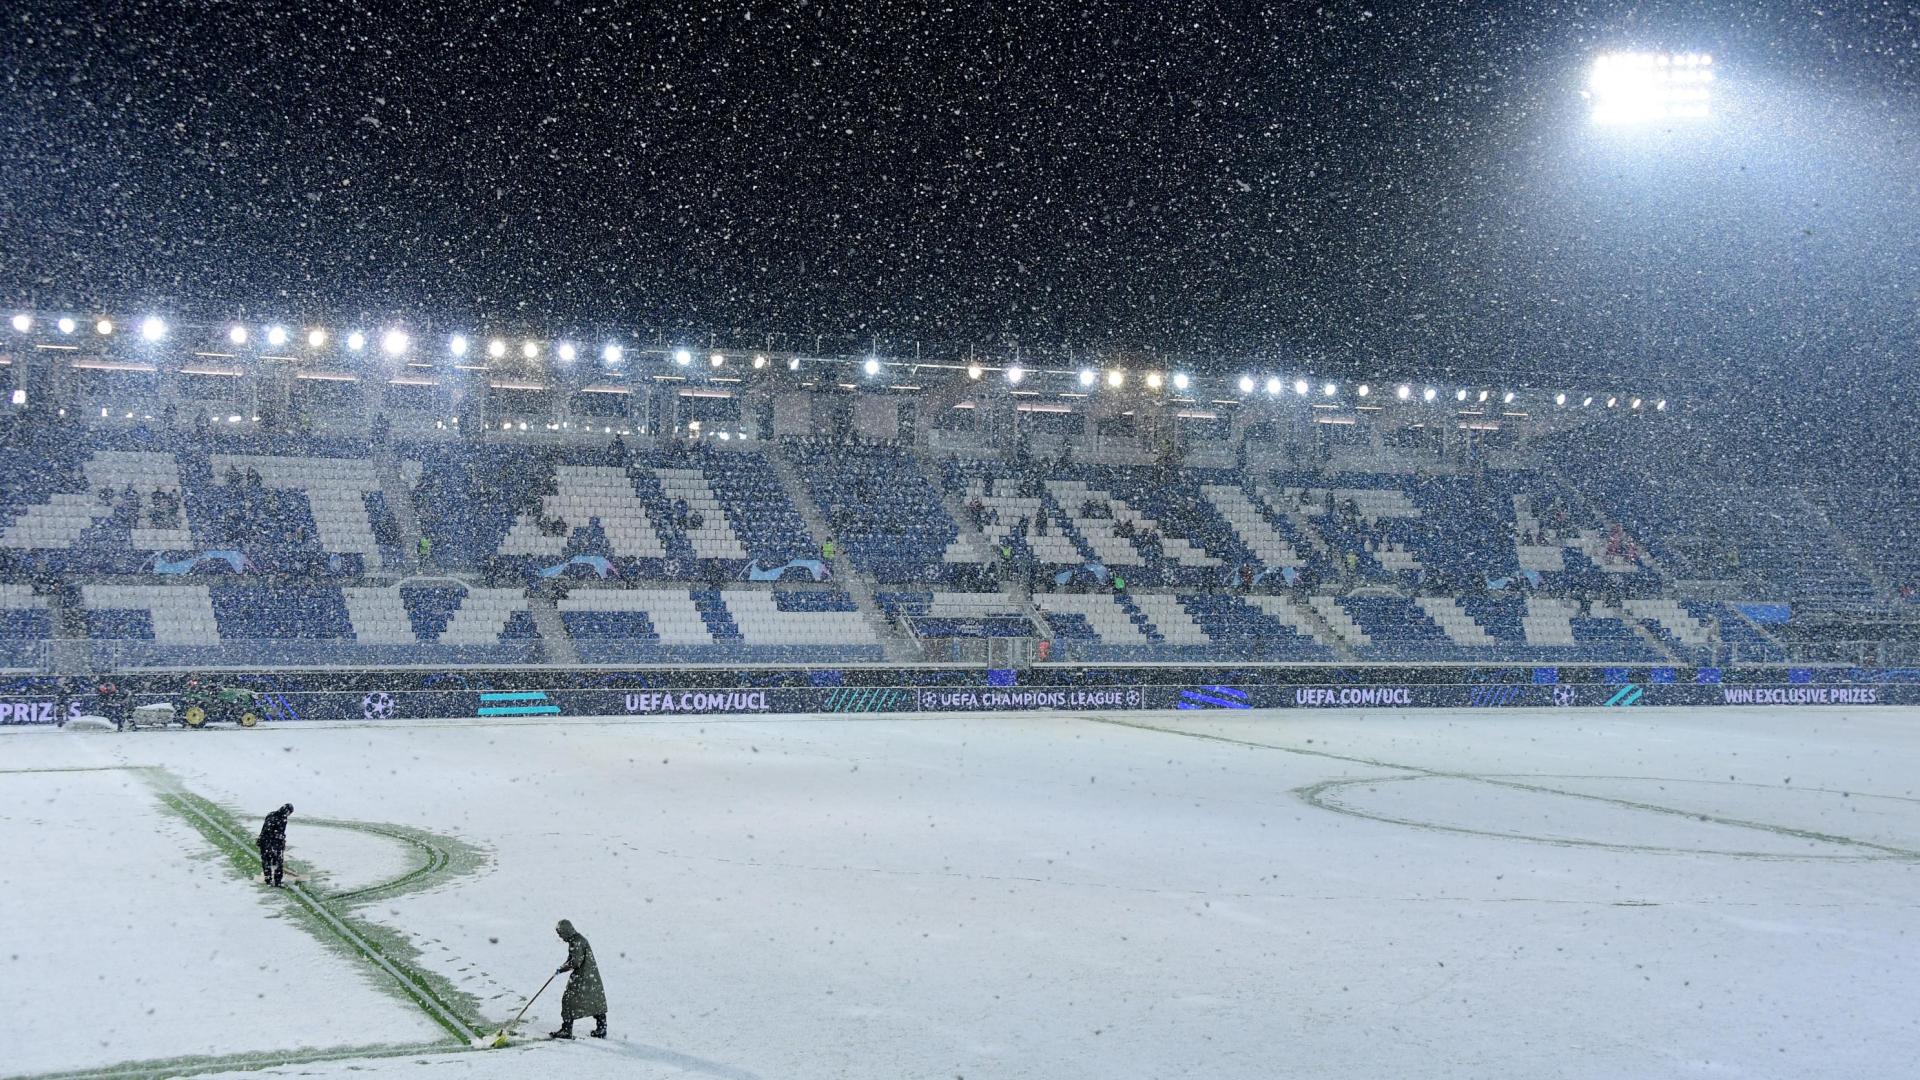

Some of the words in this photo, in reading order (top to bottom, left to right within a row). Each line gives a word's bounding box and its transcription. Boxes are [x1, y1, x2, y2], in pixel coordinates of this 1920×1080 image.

[625, 693, 770, 711] UEFA.COM/UCL
[942, 693, 978, 706] UEFA
[982, 692, 1066, 706] CHAMPIONS
[1071, 692, 1123, 706] LEAGUE
[1296, 688, 1412, 705] UEFA.COM/UCL
[1724, 688, 1753, 703] WIN
[1756, 688, 1827, 703] EXCLUSIVE
[1831, 688, 1877, 703] PRIZES
